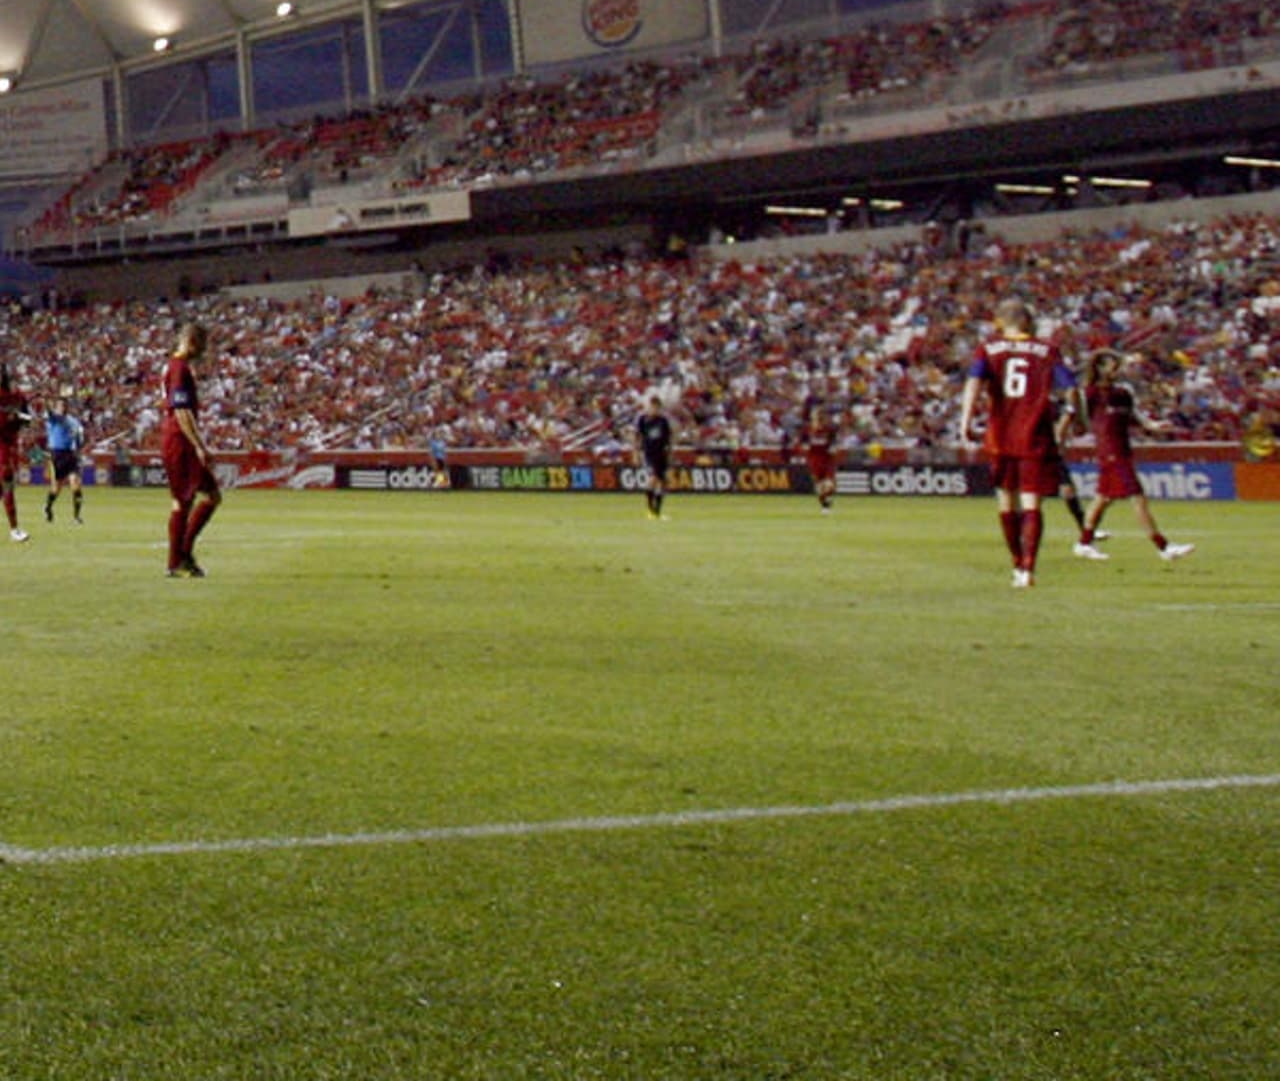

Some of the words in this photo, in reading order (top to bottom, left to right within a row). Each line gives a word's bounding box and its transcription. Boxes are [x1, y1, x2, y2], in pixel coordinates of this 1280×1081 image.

[1004, 357, 1028, 397] 6
[472, 468, 500, 488] THE
[501, 468, 547, 488] GAME
[549, 469, 568, 488] IS
[872, 466, 968, 495] adidas
